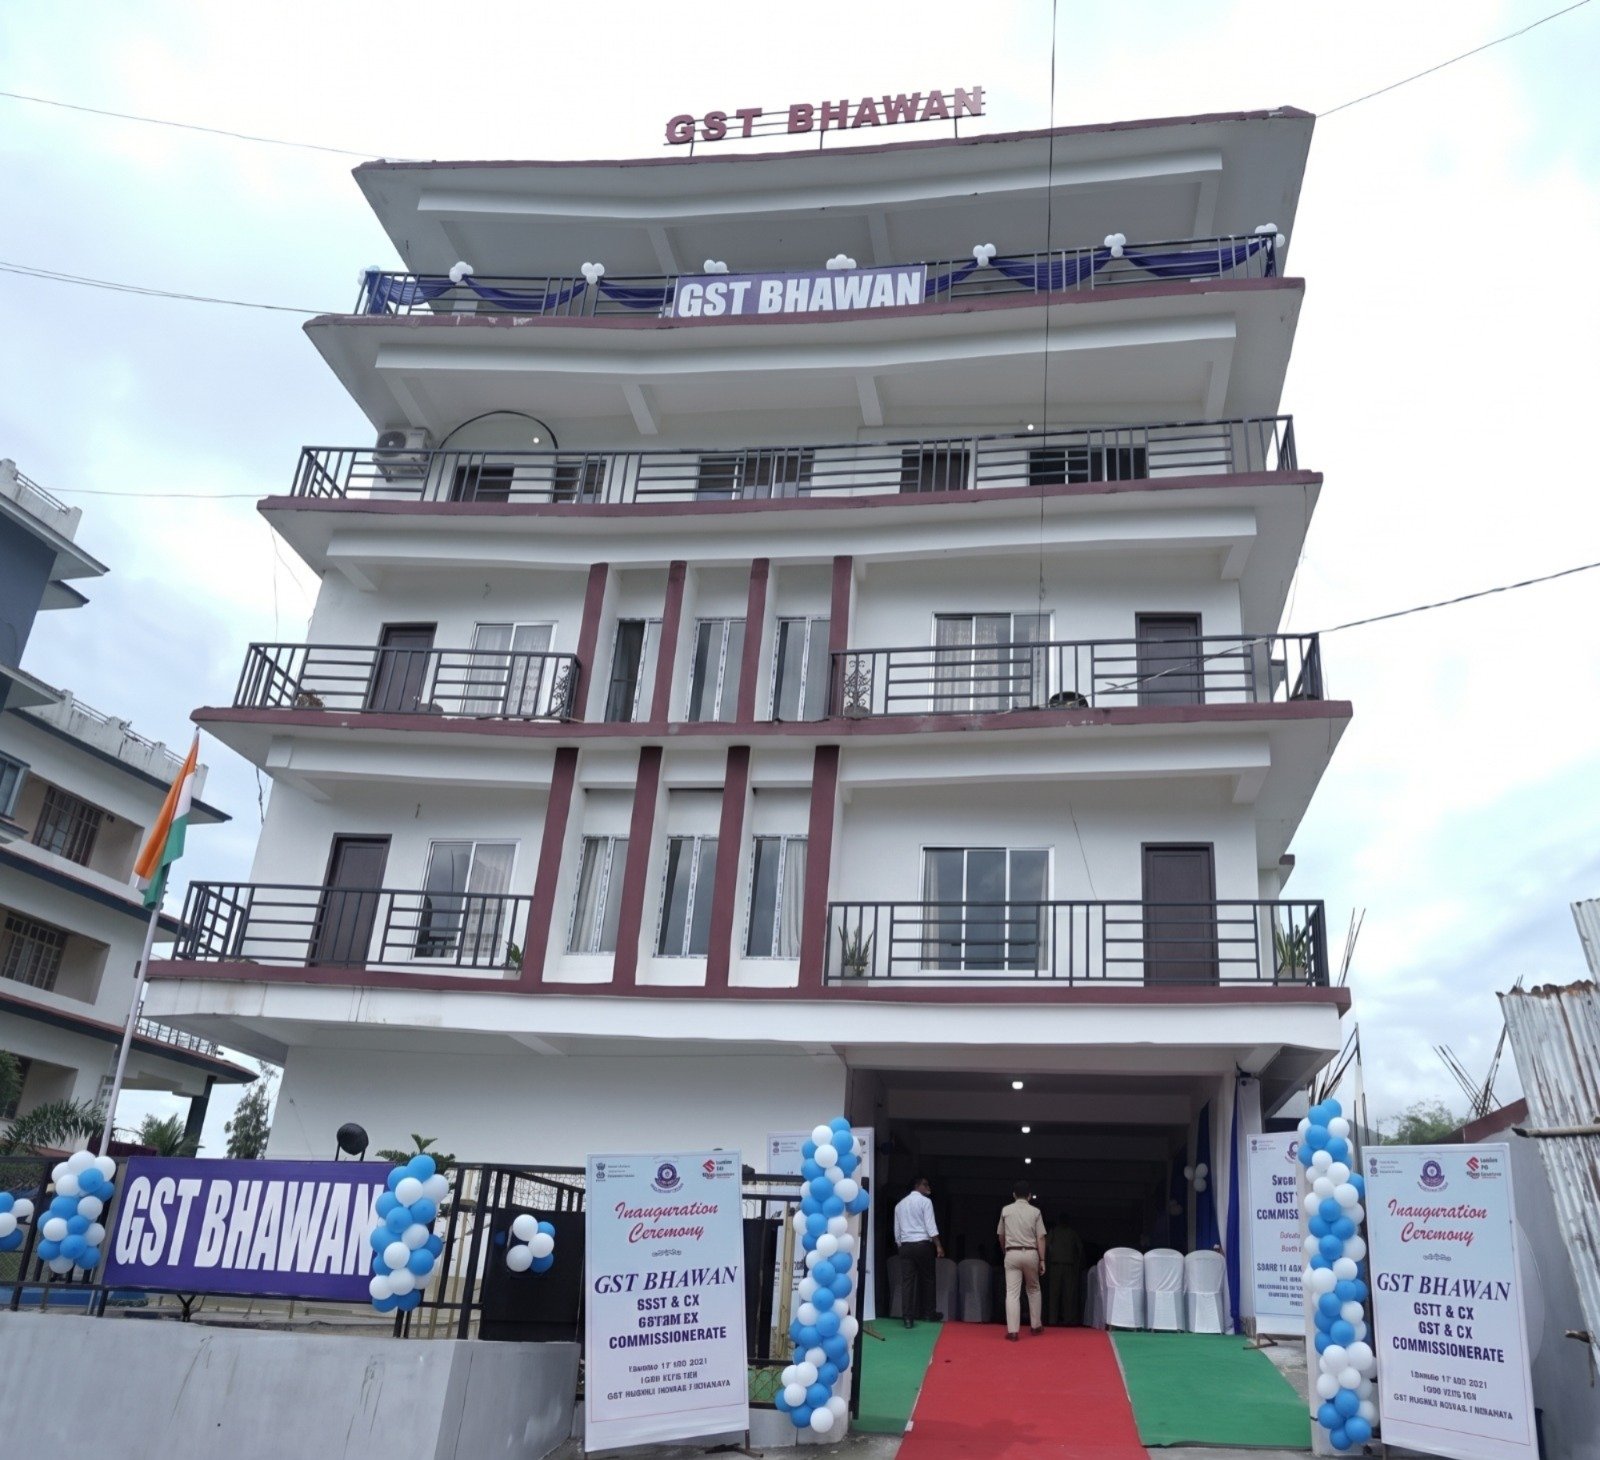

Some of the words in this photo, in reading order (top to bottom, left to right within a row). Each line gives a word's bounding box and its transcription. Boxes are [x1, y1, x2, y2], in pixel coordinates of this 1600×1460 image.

[665, 107, 763, 145] GST
[788, 85, 983, 134] BHAWAN
[678, 281, 752, 318] GST
[757, 271, 922, 314] BHAWAN
[614, 1201, 719, 1223] Inauguration
[1388, 1199, 1488, 1223] Inauguration
[115, 1175, 203, 1268] GST
[193, 1179, 386, 1277] BHAWAN
[628, 1222, 704, 1243] Ceremony
[1400, 1221, 1474, 1246] Ceremony
[594, 1273, 639, 1294] GST
[643, 1265, 738, 1291] BHAWAN
[1376, 1272, 1414, 1293] GST
[1418, 1275, 1511, 1301] BHAWAN
[670, 1295, 680, 1308] &
[683, 1294, 700, 1307] CX
[1413, 1301, 1442, 1317] GSTT
[1445, 1305, 1454, 1318] &
[1458, 1306, 1474, 1320] CX
[609, 1326, 727, 1349] COMMISSIONERATE
[1418, 1321, 1440, 1335] GST
[1444, 1323, 1453, 1337] &
[1456, 1325, 1473, 1339] CX
[1392, 1336, 1505, 1363] COMMISSIONERATE
[689, 1357, 708, 1366] 2021
[1469, 1379, 1488, 1389] 2021
